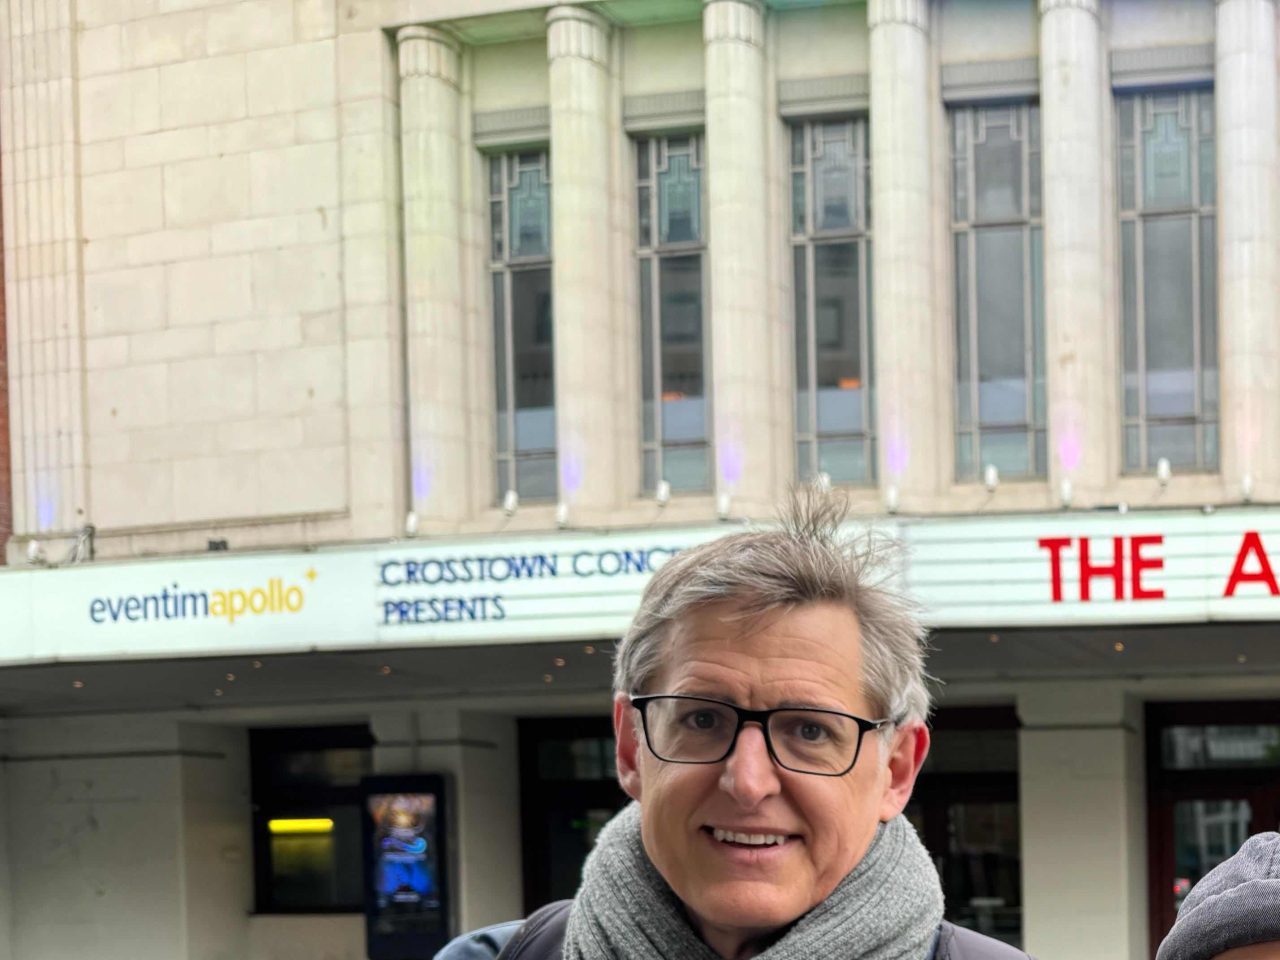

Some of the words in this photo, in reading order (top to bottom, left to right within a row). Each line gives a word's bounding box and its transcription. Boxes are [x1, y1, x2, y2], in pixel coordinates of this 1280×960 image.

[381, 554, 558, 586] CROSSTOWN
[572, 546, 681, 577] CONC
[1038, 534, 1165, 603] THE
[89, 577, 304, 624] eventimapollo
[383, 595, 506, 625] PRESENTS
